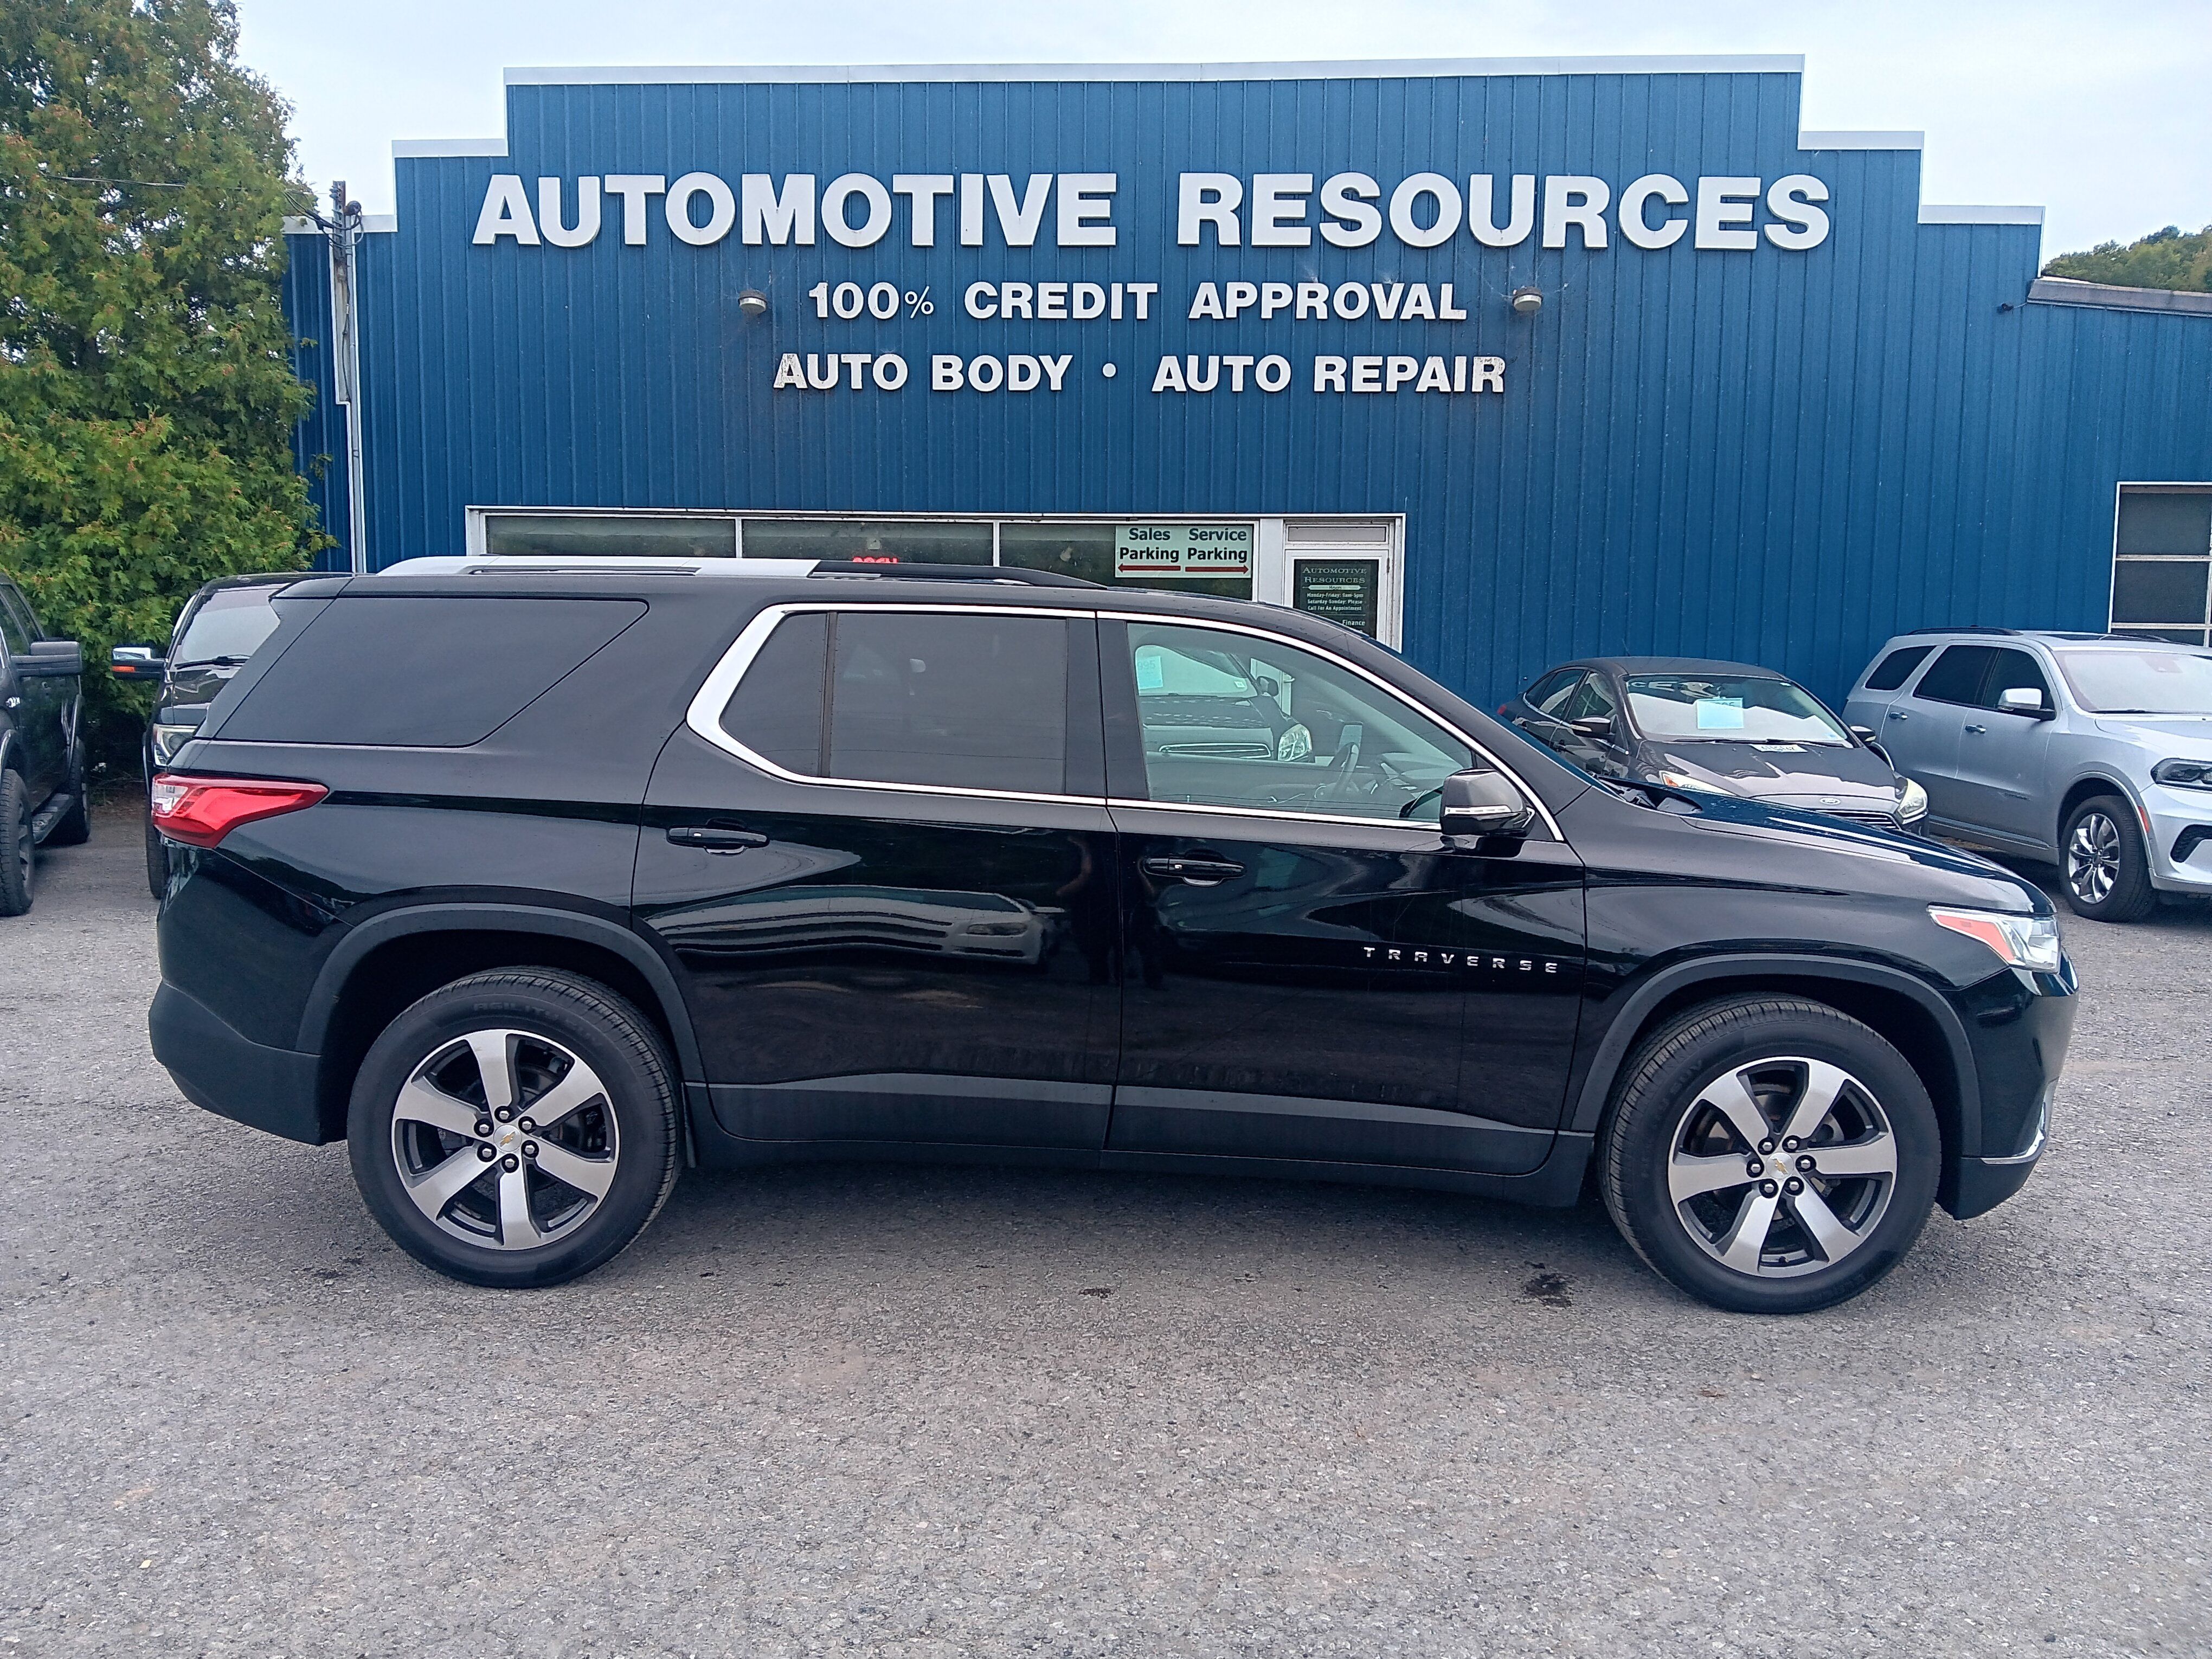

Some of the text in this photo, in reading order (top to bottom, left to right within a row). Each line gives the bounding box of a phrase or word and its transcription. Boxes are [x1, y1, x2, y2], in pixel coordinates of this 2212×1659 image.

[471, 172, 1830, 250] AUTOMOTIVE RESOURCES
[808, 281, 1467, 320] 100% CREDIT APPROVAL
[773, 353, 1506, 393] AUTO BODY AUTO REPAIR
[1129, 527, 1171, 541] Sales
[1188, 527, 1247, 541] Service
[1120, 546, 1179, 563] Parking
[1187, 547, 1248, 563] Parking
[1362, 946, 1558, 974] TRAVERSE
